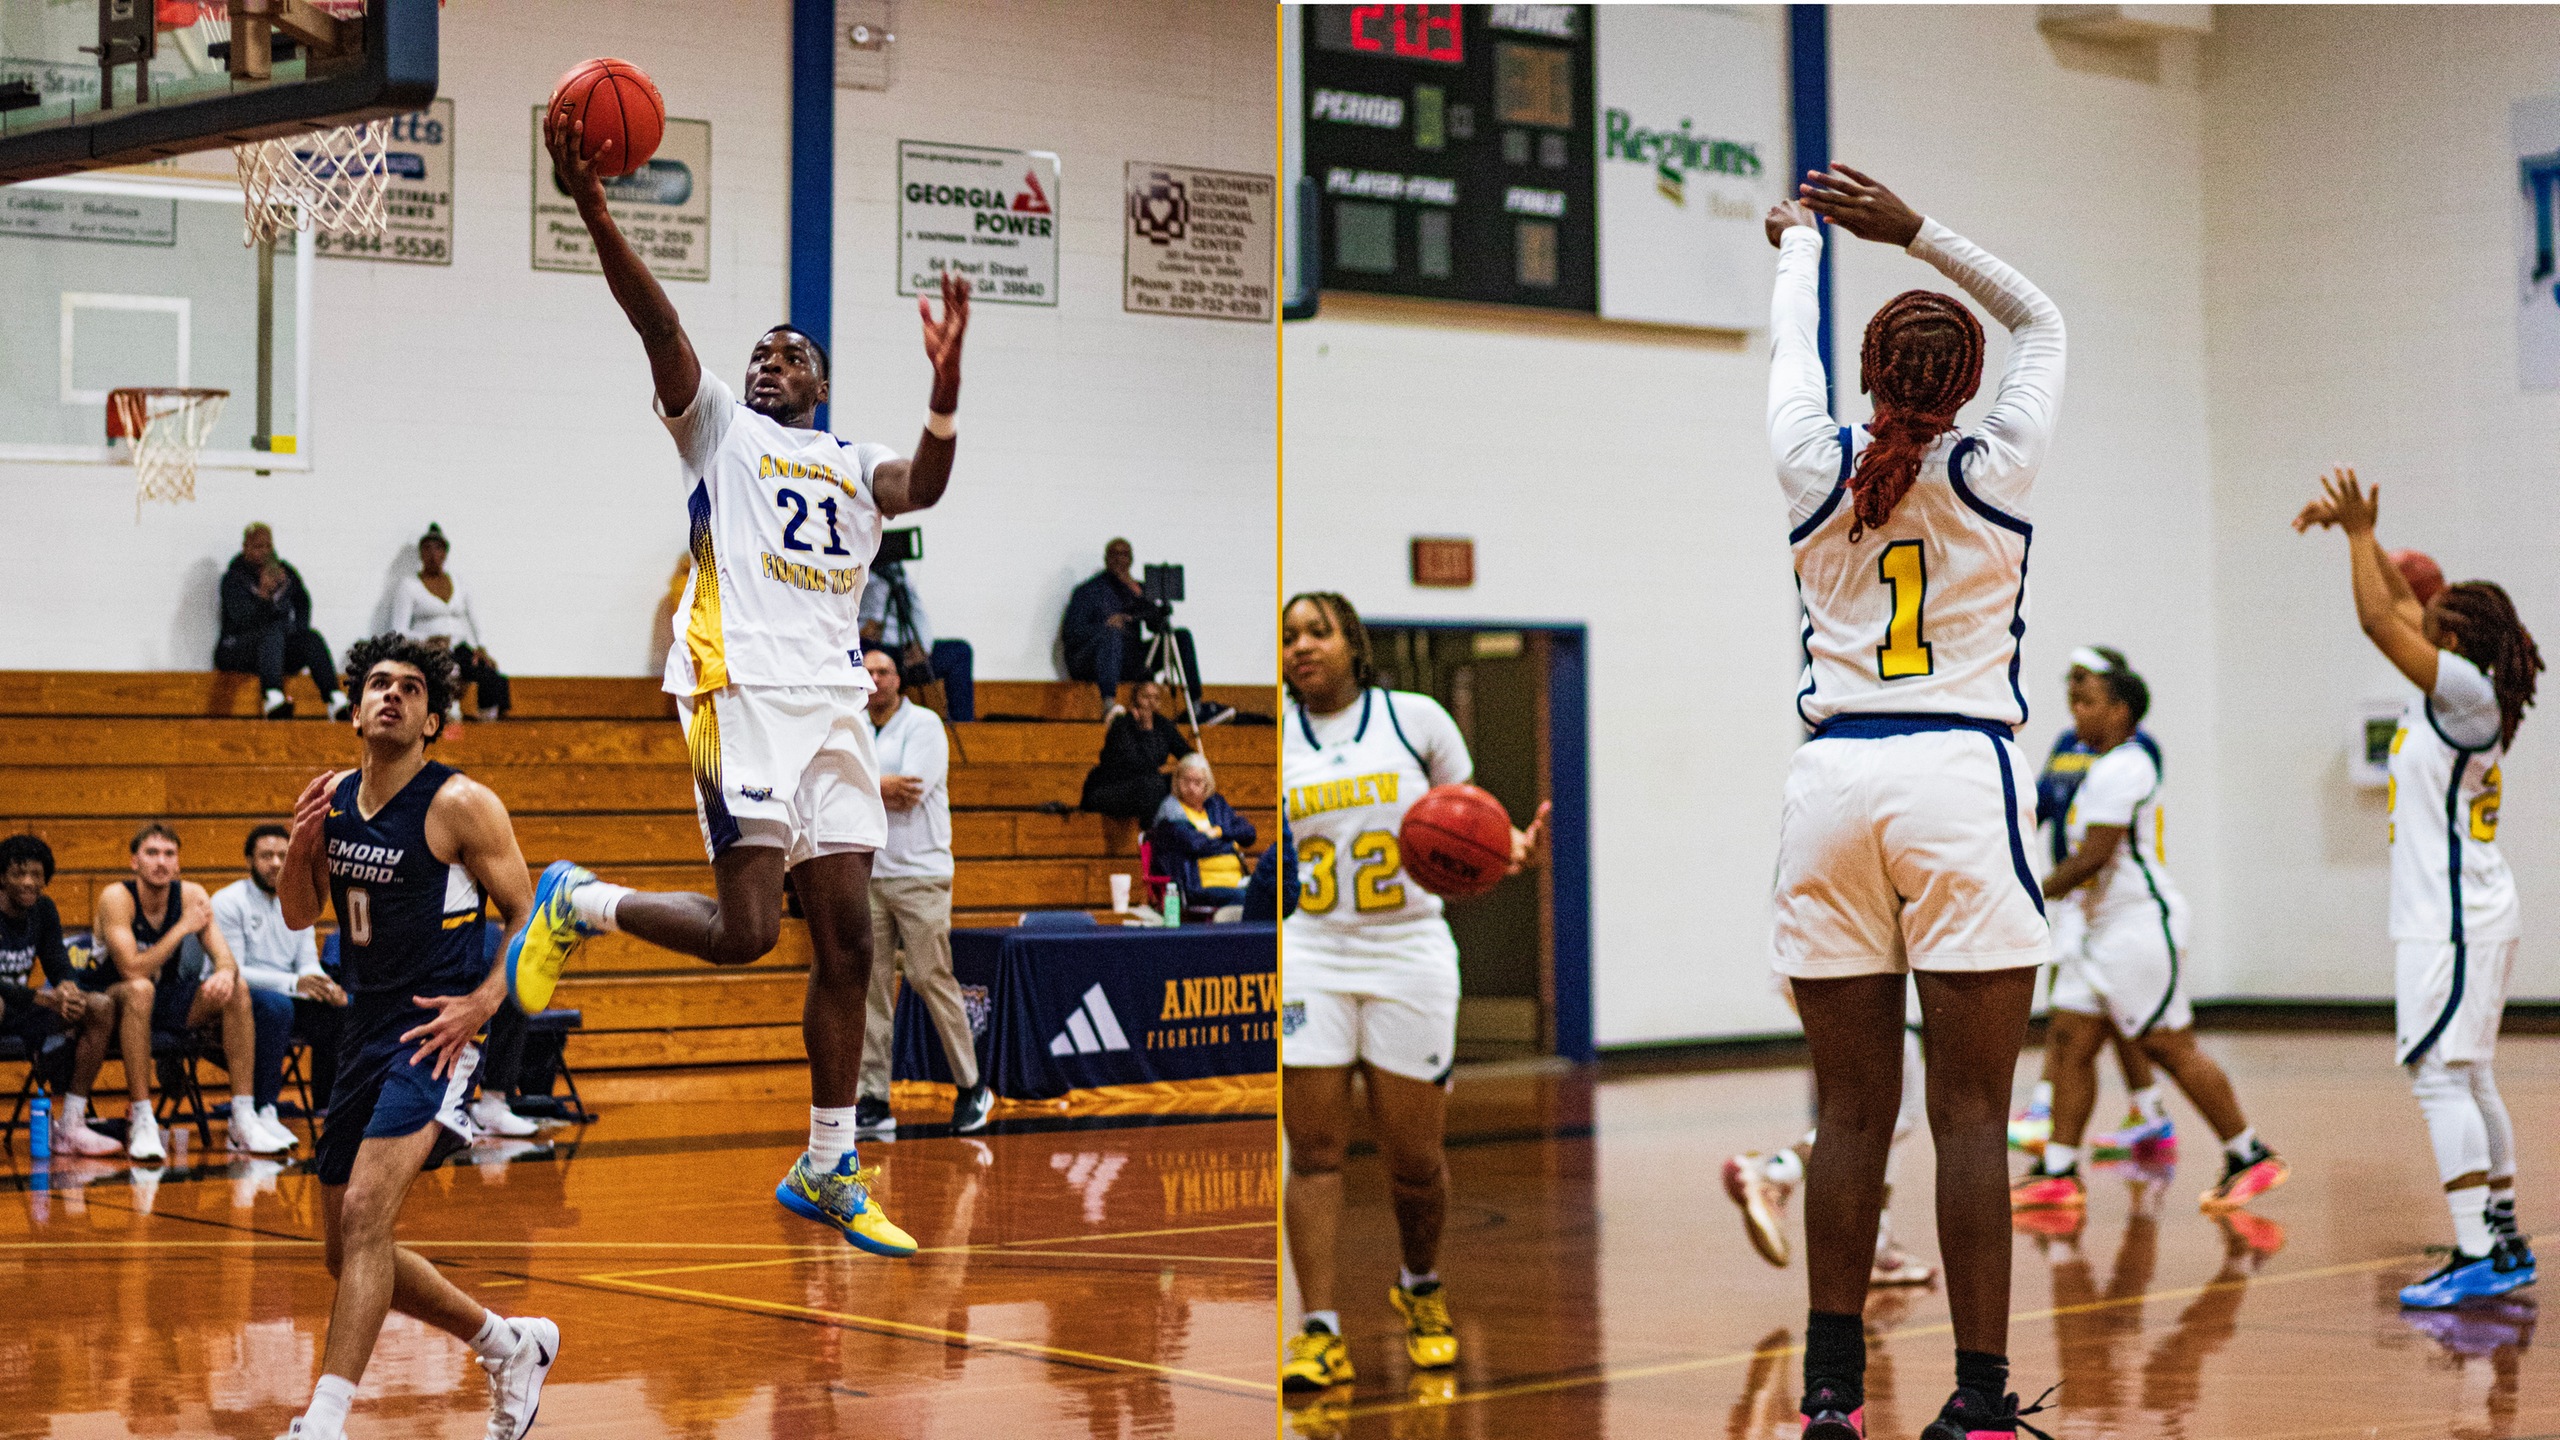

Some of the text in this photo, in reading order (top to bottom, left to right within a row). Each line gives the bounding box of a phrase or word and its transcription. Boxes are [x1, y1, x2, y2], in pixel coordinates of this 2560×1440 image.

[1311, 88, 1404, 129] PERIOD
[1605, 108, 1764, 184] Regions
[905, 182, 1007, 209] GEORGIA
[1191, 174, 1270, 194] SOUTHWEST
[1192, 189, 1249, 207] GEORGIA
[975, 211, 1052, 237] POWER
[1192, 204, 1253, 224] REGIONAL
[1191, 236, 1243, 253] CENTER
[1192, 221, 1247, 240] MEDICAL
[989, 260, 1030, 278] Street
[977, 276, 998, 293] GA
[759, 454, 858, 499] ANDREW
[775, 487, 851, 556] 21
[761, 552, 827, 593] FIGHTING
[1877, 539, 1933, 680] 1
[1289, 772, 1399, 822] ANDREW
[327, 837, 405, 866] EMORY
[1298, 829, 1406, 915] 32
[346, 886, 372, 947] 0
[1160, 972, 1277, 1021] ANDREW
[1147, 1024, 1230, 1050] FIGHTING
